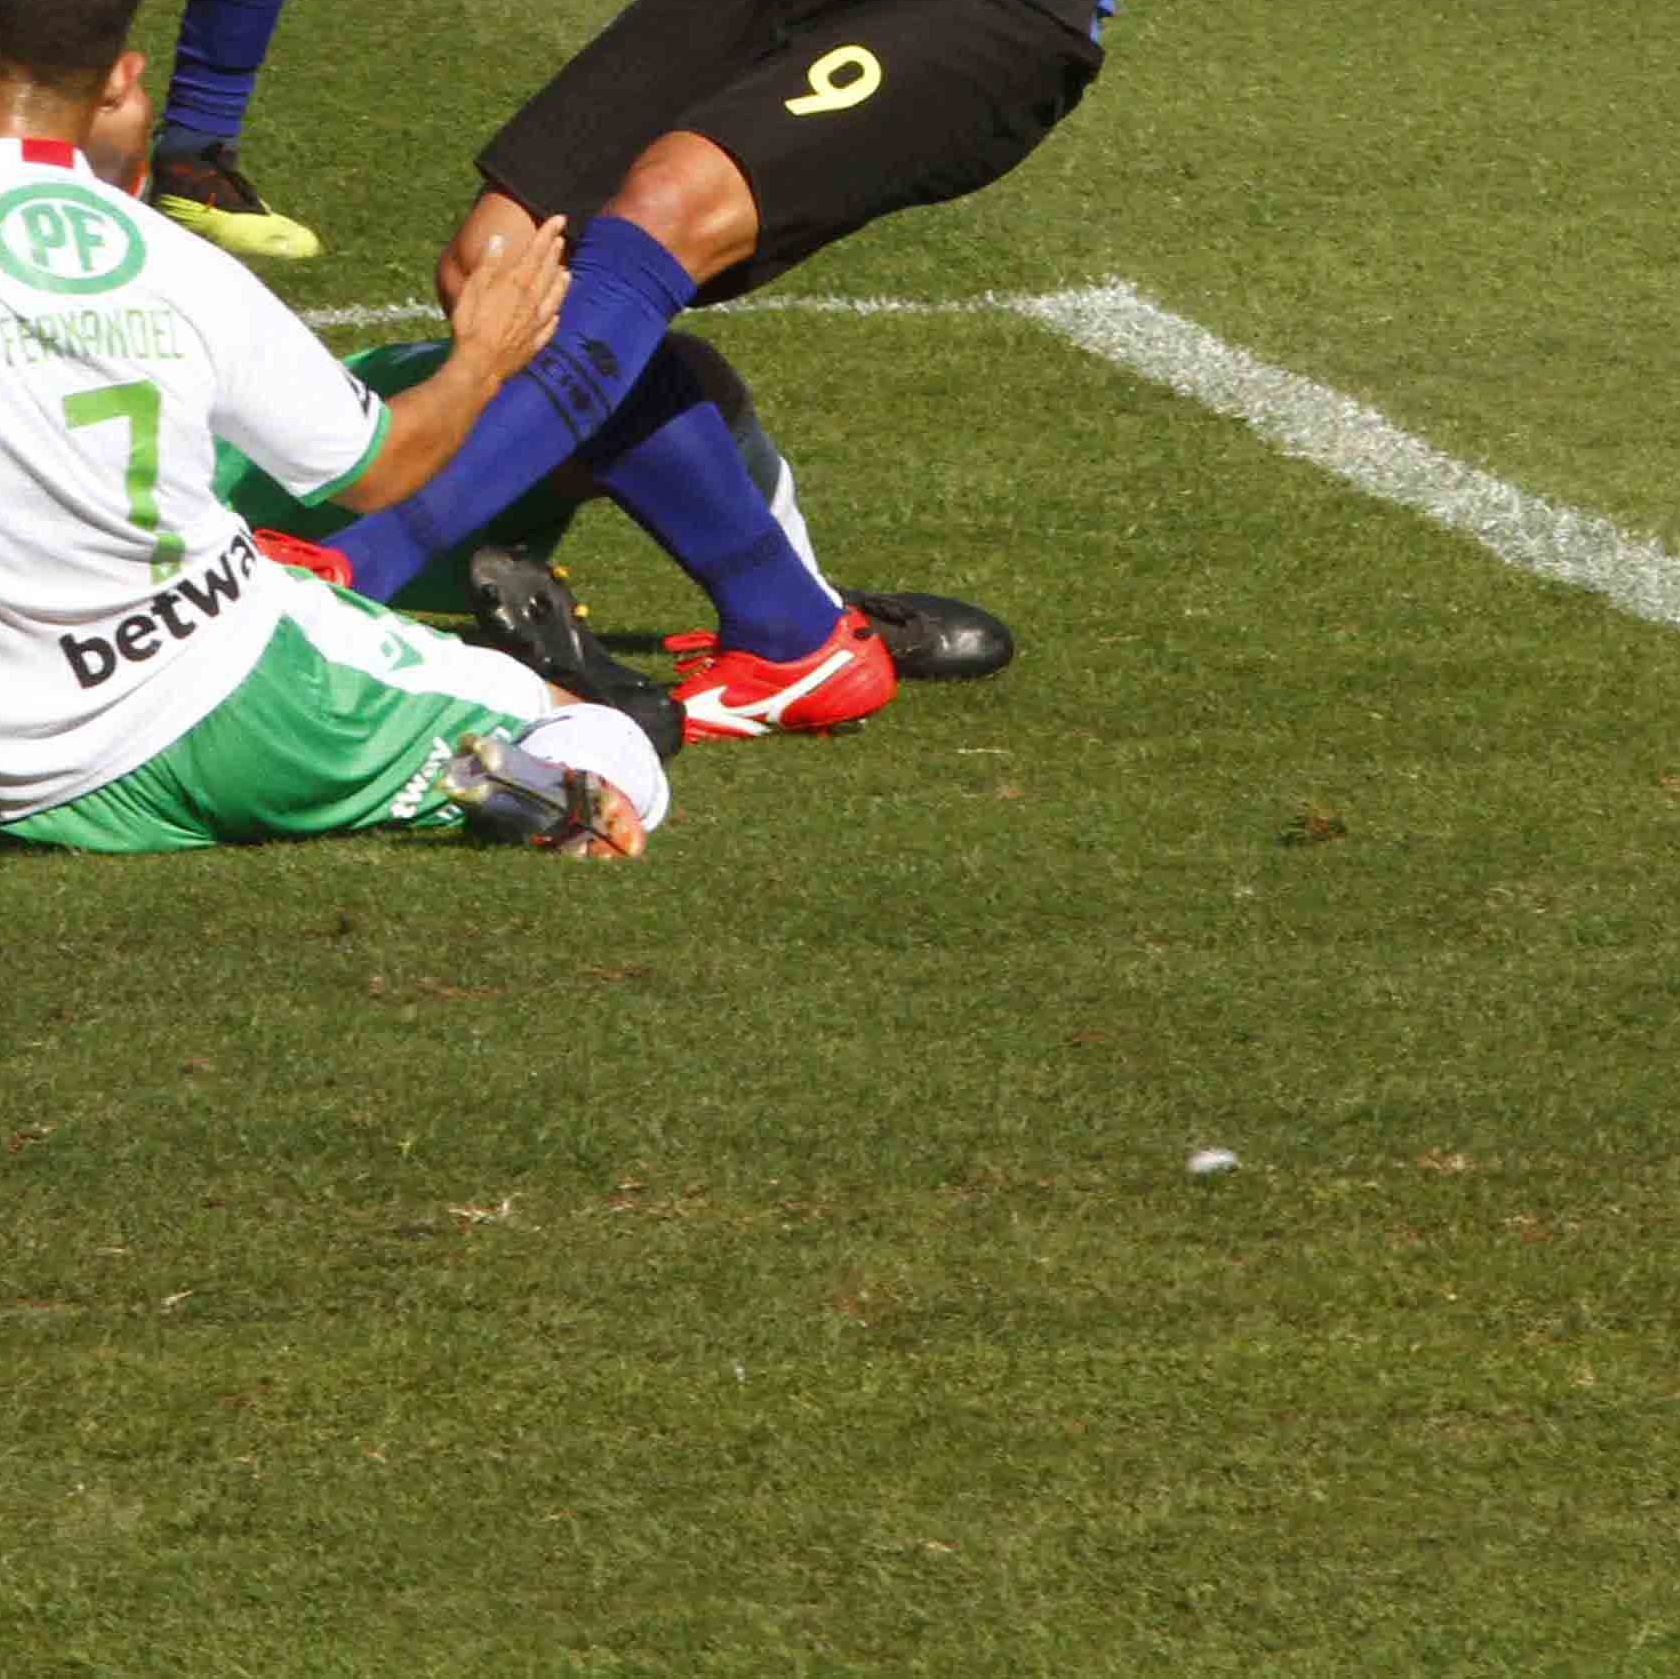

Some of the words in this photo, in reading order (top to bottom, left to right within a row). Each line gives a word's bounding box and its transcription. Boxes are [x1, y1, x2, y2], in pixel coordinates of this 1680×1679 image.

[784, 45, 881, 115] 9
[22, 203, 107, 272] PF
[63, 380, 186, 586] 7
[59, 527, 256, 689] betwa
